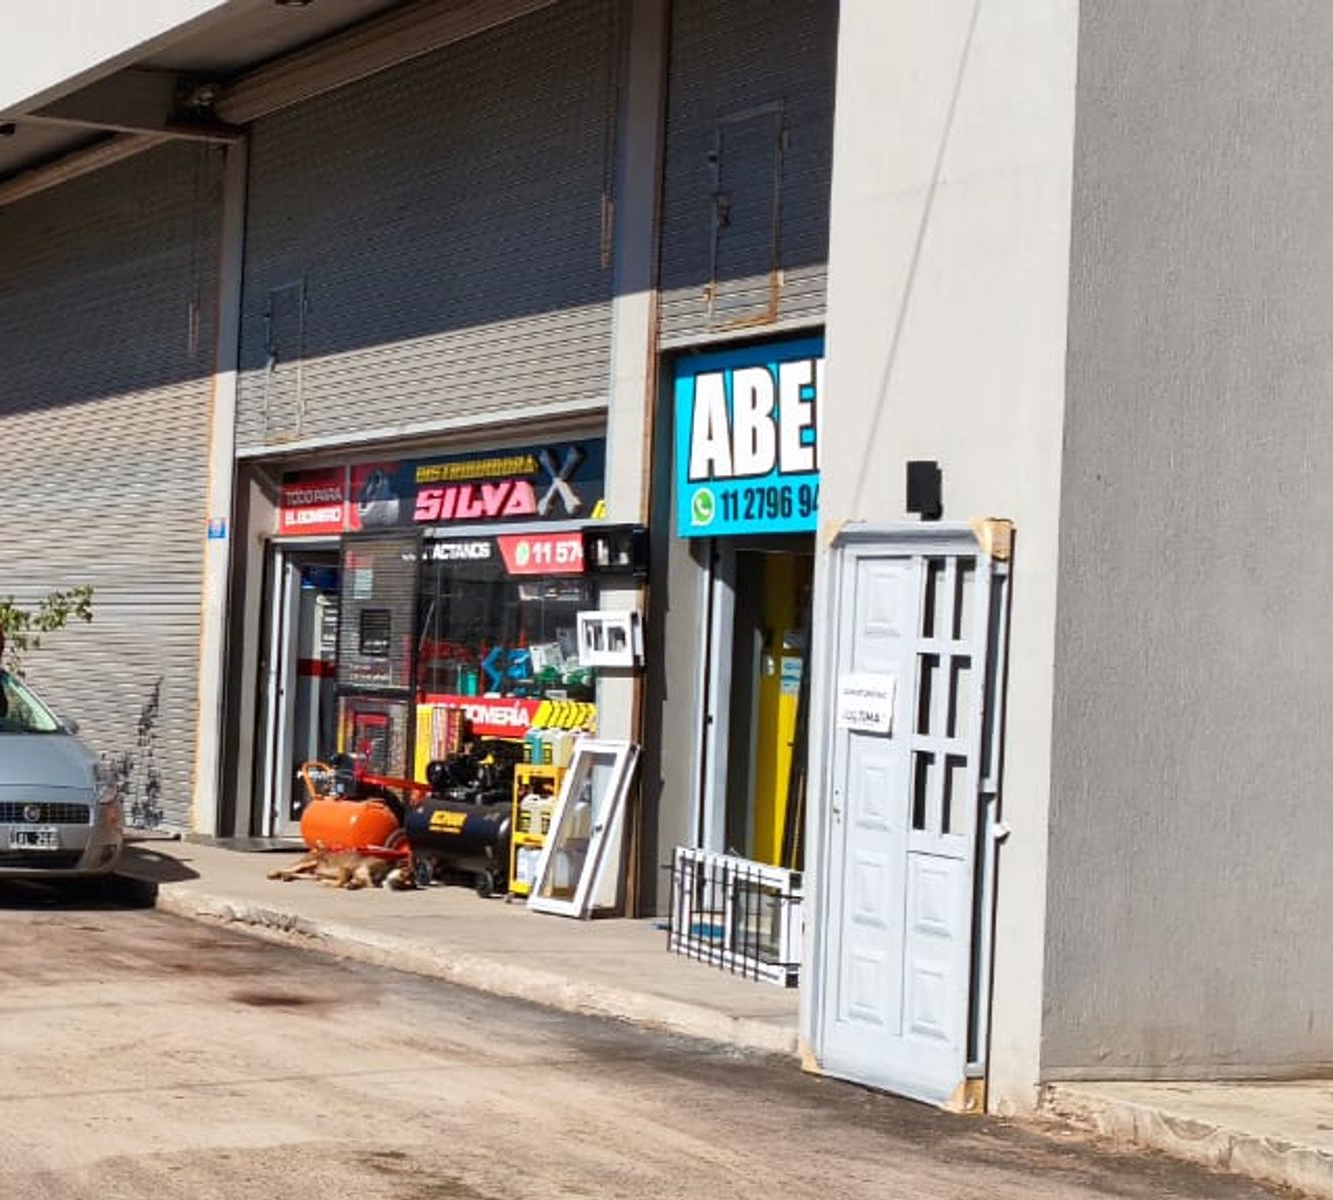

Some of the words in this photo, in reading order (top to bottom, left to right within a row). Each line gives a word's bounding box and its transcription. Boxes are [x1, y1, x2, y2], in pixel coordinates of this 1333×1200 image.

[689, 359, 824, 482] ABE
[414, 480, 537, 522] SILVA
[721, 489, 738, 521] 11
[744, 485, 792, 520] 2796
[533, 542, 552, 564] 11
